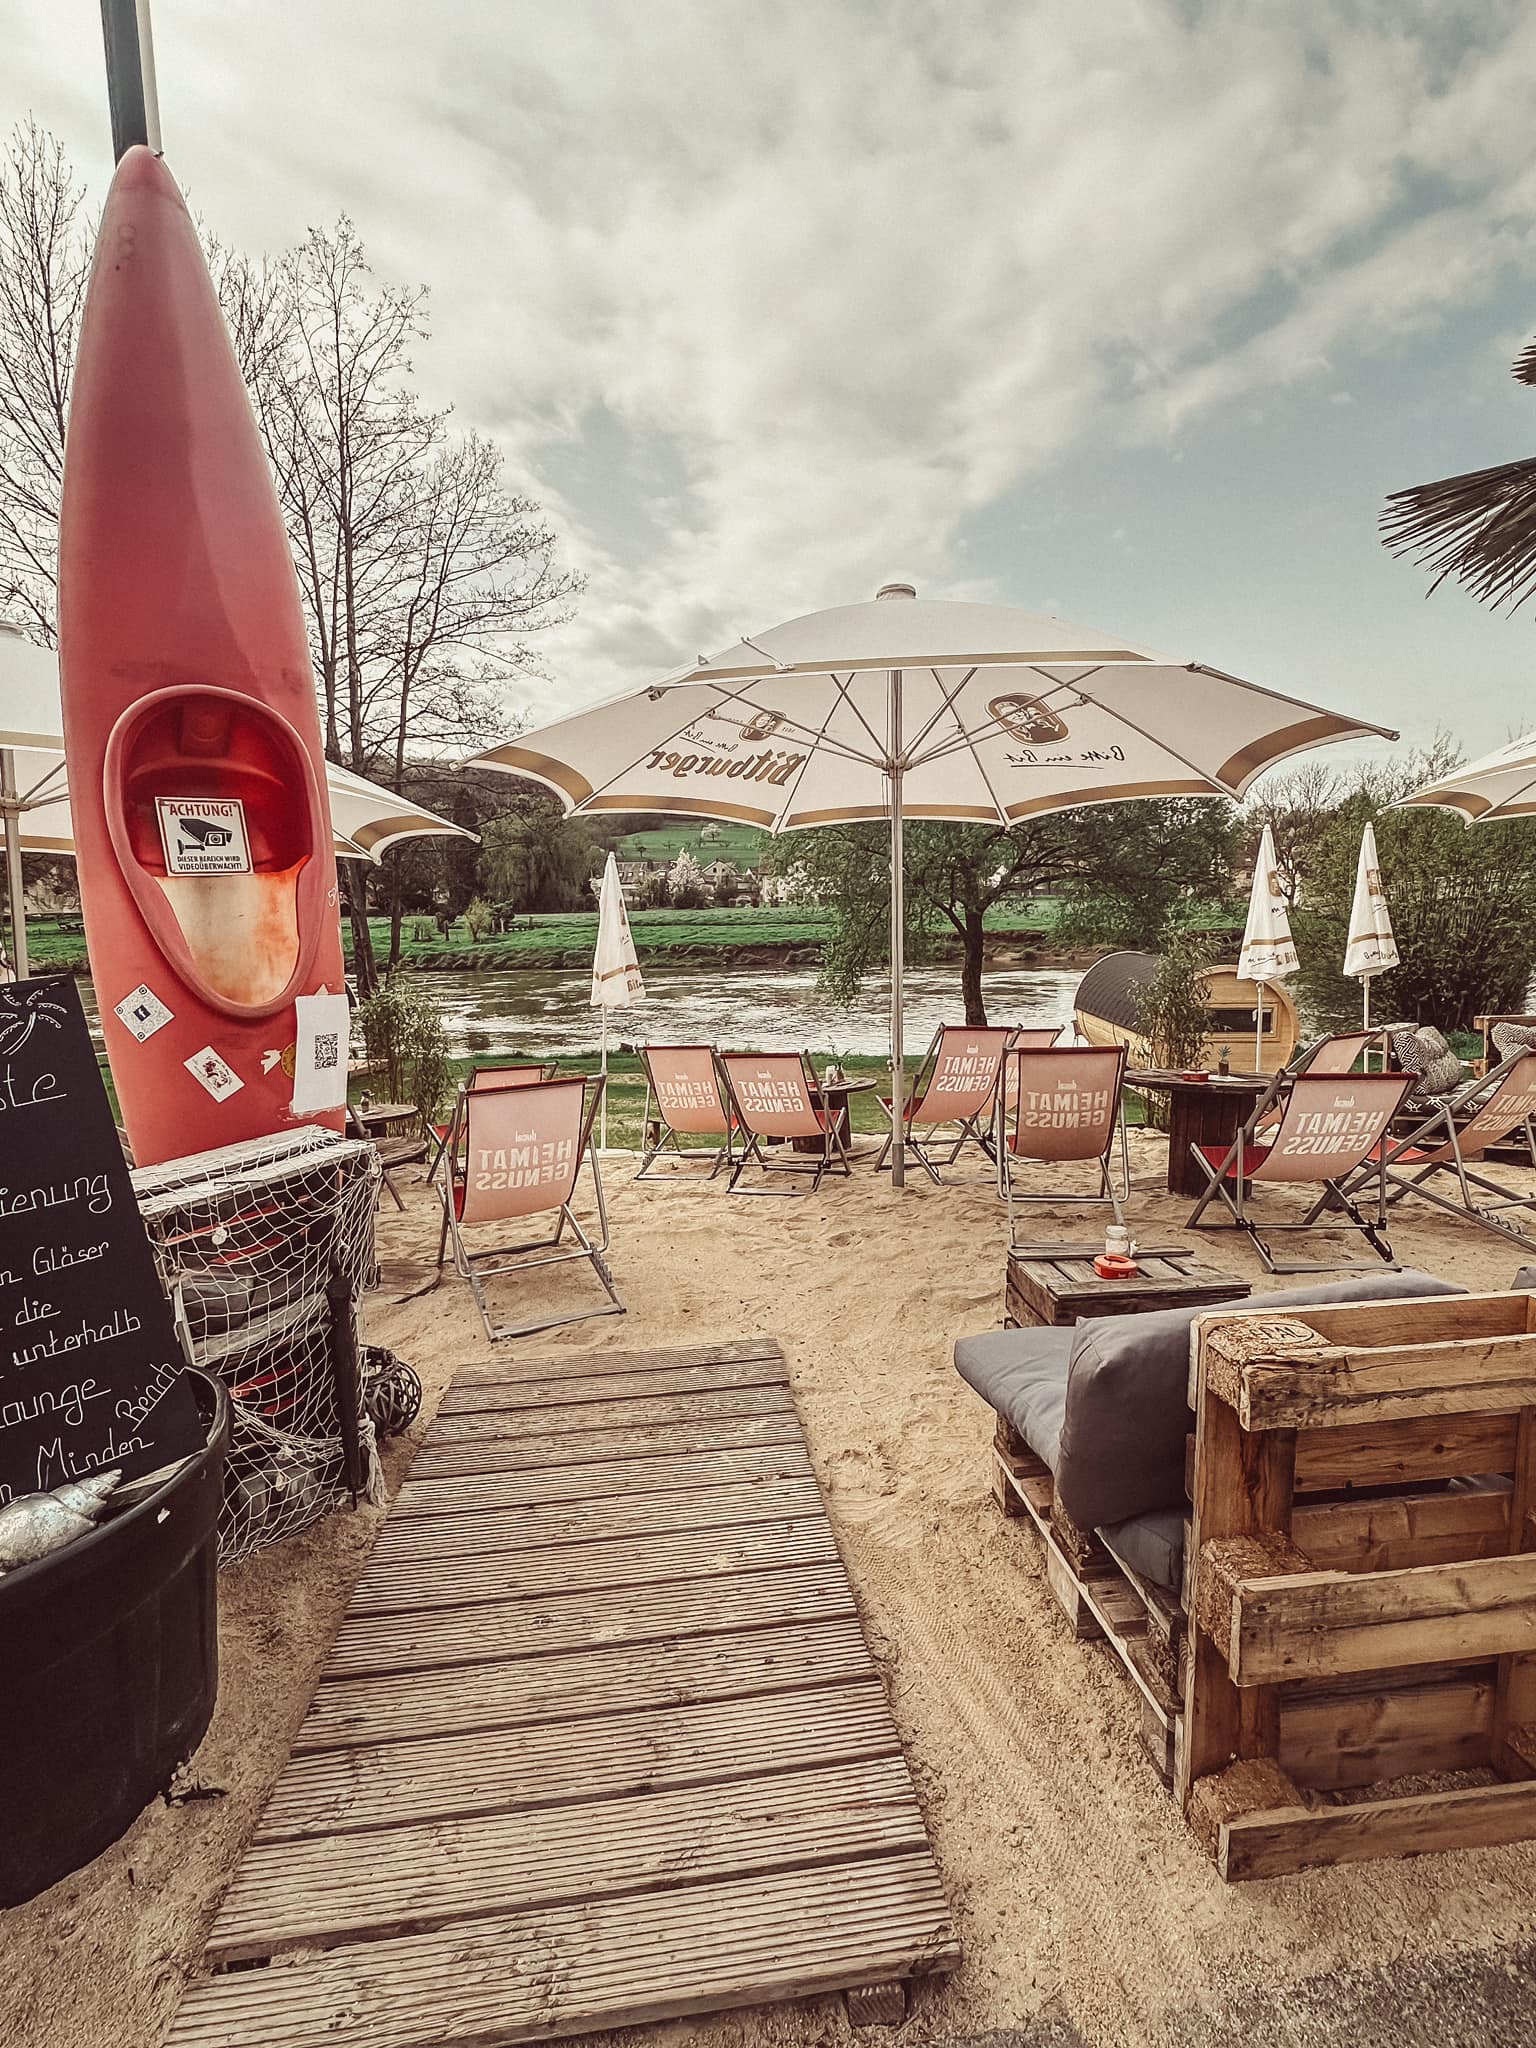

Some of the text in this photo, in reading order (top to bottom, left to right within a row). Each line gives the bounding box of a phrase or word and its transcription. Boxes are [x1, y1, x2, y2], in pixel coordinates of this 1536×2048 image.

[169, 803, 233, 817] ACHTUNG!
[0, 1064, 67, 1111] te
[33, 1241, 109, 1275] Gläser
[15, 1296, 61, 1326] die
[12, 1308, 141, 1366] unterhalb
[0, 1379, 112, 1429] ounge
[115, 1363, 184, 1432] Beach
[37, 1427, 155, 1490] Minden
